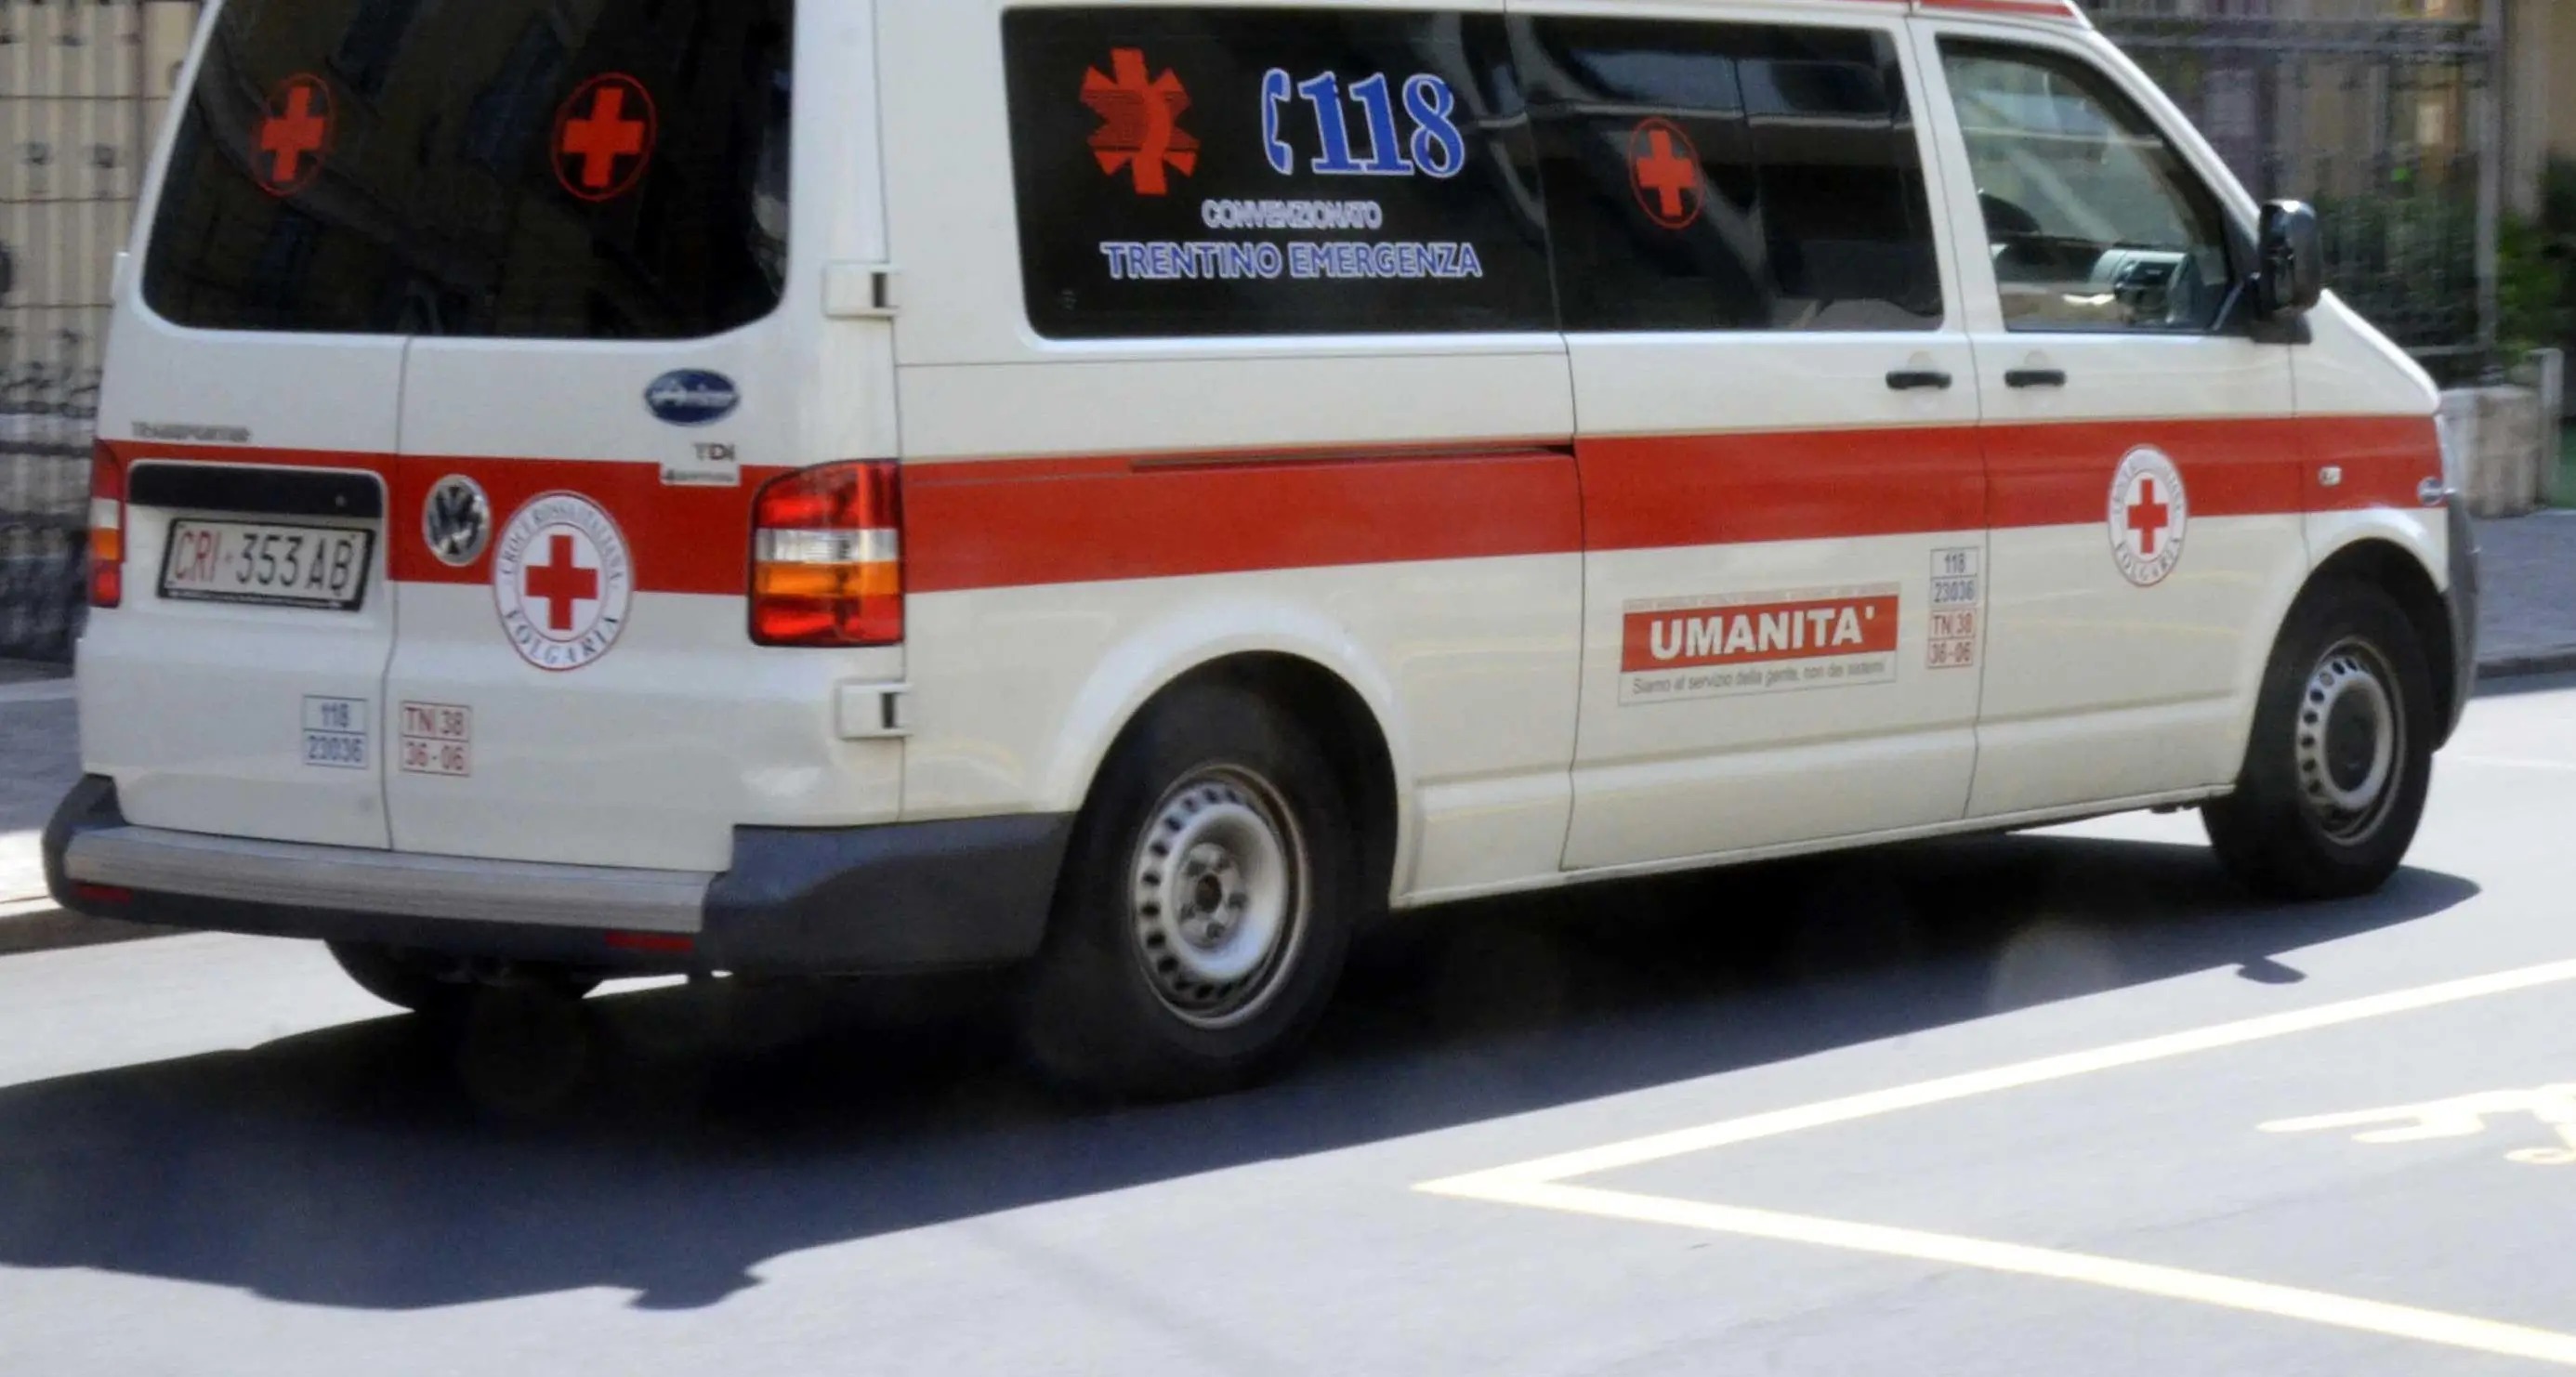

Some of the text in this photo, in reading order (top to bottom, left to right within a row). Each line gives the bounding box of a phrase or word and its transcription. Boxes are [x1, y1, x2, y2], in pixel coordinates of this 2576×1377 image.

[1297, 71, 1466, 178] 118
[1201, 198, 1383, 230] CONVENZIONATO
[1099, 241, 1483, 279] TRENTINO EMERGENZA
[1944, 552, 1967, 574] 118
[1649, 605, 1875, 662] UMANITA'
[1933, 614, 1951, 636] TN
[321, 702, 350, 728] 118
[404, 706, 465, 737] TN 38
